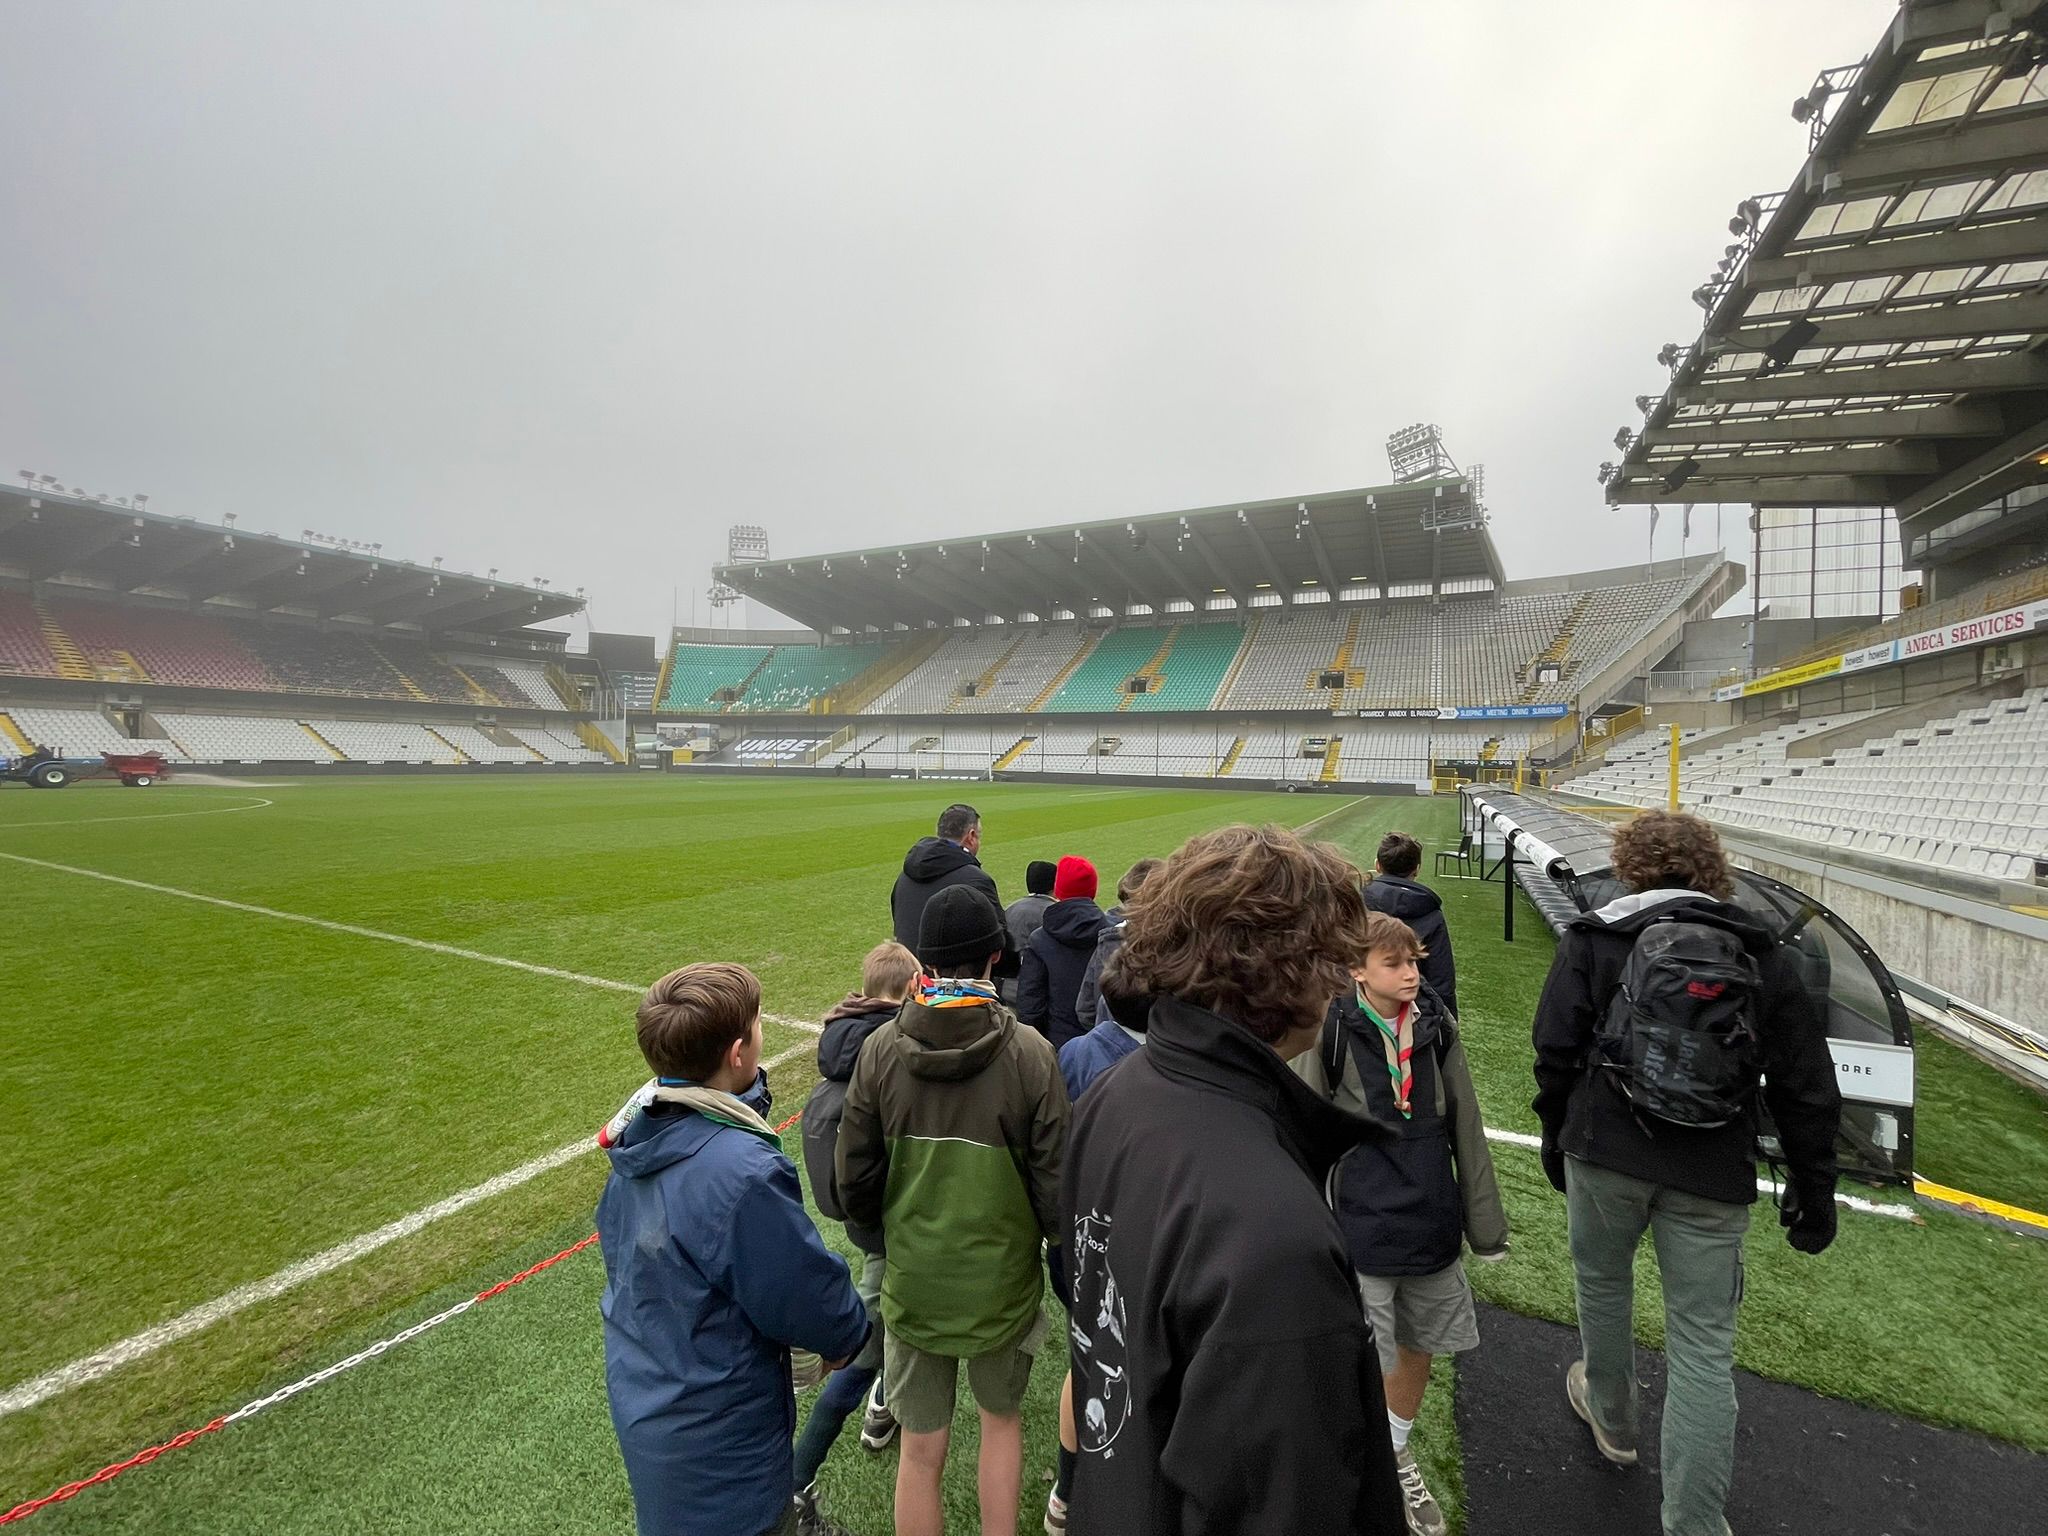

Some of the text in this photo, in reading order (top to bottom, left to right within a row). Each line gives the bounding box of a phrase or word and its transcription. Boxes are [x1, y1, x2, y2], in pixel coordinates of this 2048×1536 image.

[1904, 611, 2025, 655] ANECA SERVICES
[1868, 647, 1890, 661] howest
[735, 739, 831, 752] UNIBET
